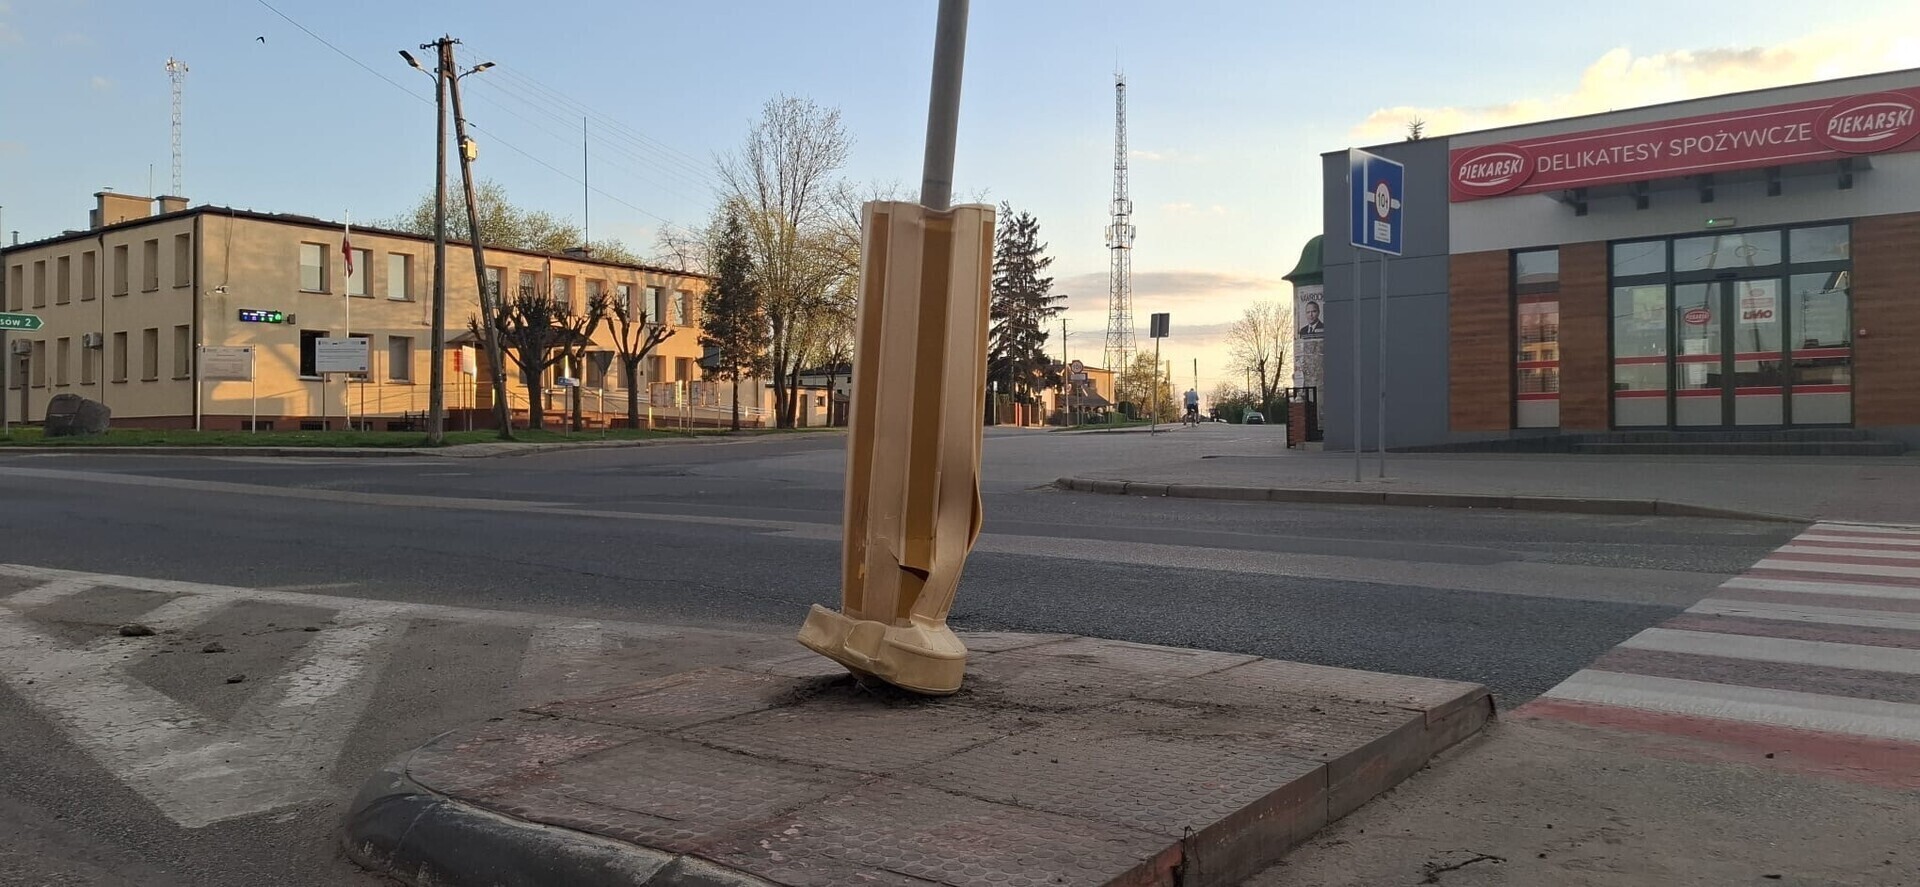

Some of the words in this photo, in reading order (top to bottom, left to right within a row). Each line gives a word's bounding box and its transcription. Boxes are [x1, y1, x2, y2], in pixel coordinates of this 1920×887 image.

[1827, 108, 1915, 135] PIEKARSKI
[1537, 141, 1663, 173] DELIKATESY
[1669, 122, 1812, 157] SPOŻYWCZE
[1458, 157, 1524, 180] PIEKARSKI
[24, 318, 31, 327] 2
